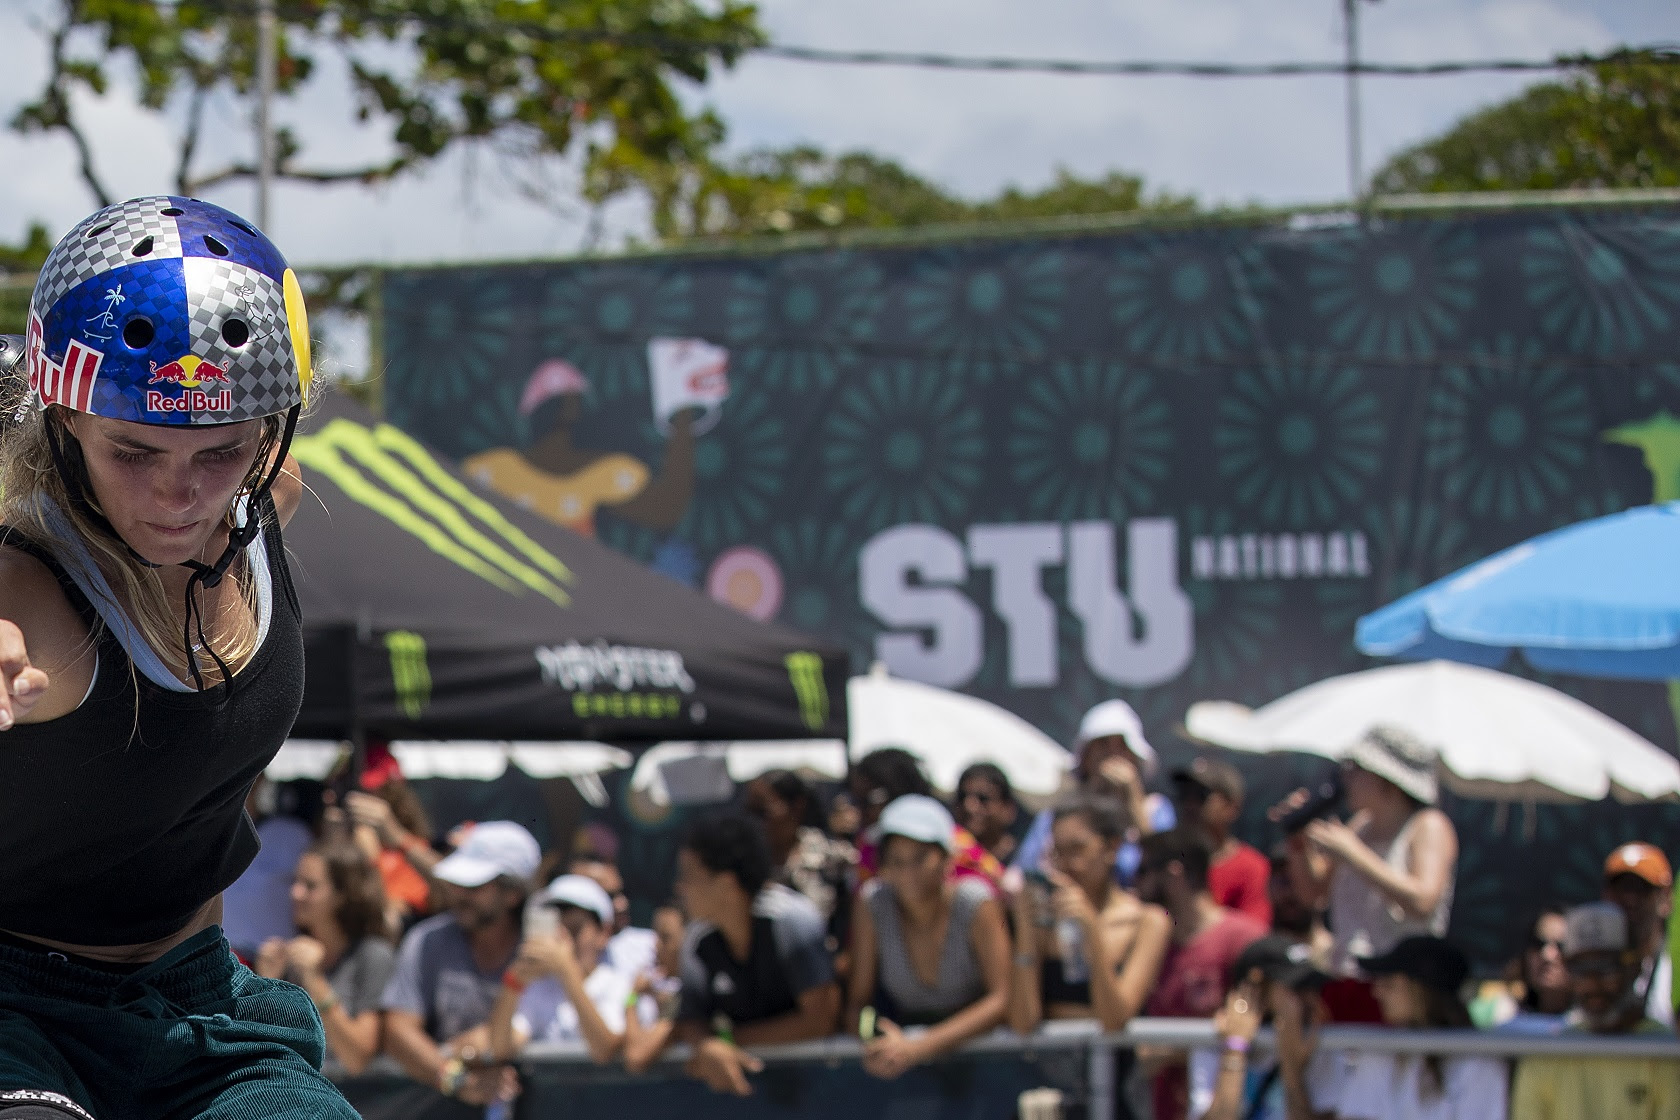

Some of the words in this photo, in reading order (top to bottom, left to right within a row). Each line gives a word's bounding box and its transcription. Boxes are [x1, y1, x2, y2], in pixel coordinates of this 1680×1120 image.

[147, 390, 188, 412] Red
[191, 390, 231, 412] Bull
[858, 517, 1193, 688] STU
[1192, 531, 1372, 579] NATIONAL
